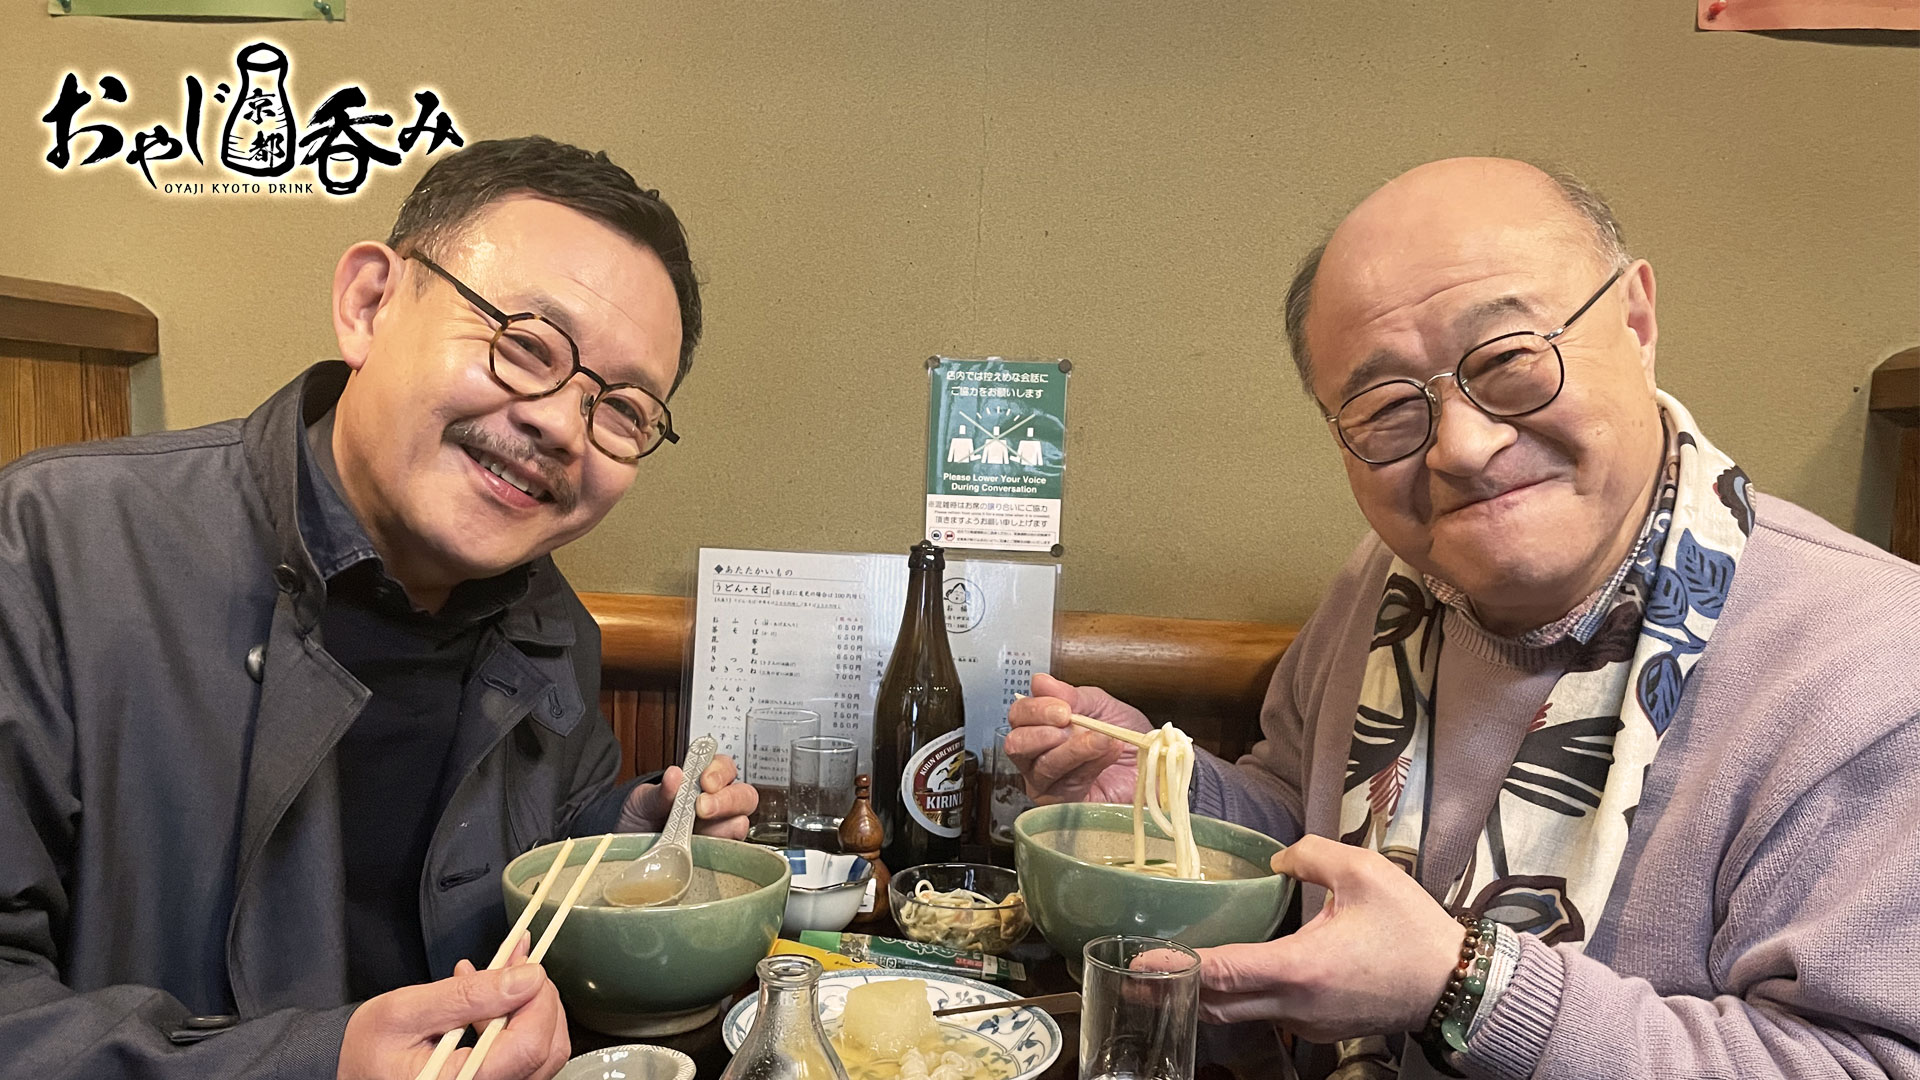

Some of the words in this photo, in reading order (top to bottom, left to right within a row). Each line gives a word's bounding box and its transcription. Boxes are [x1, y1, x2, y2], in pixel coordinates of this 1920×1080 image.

[946, 370, 1049, 383] 店内では控えめな会話に
[950, 385, 1044, 399] ご協力をお願いします
[943, 472, 971, 481] Please
[972, 474, 999, 483] Lower
[1000, 475, 1021, 484] Your
[1022, 476, 1047, 485] Voice
[951, 482, 980, 493] During
[981, 484, 1037, 494] Conversation
[715, 582, 771, 595] うどん・そば
[919, 757, 936, 776] KIRIN
[926, 792, 959, 809] KIRIN
